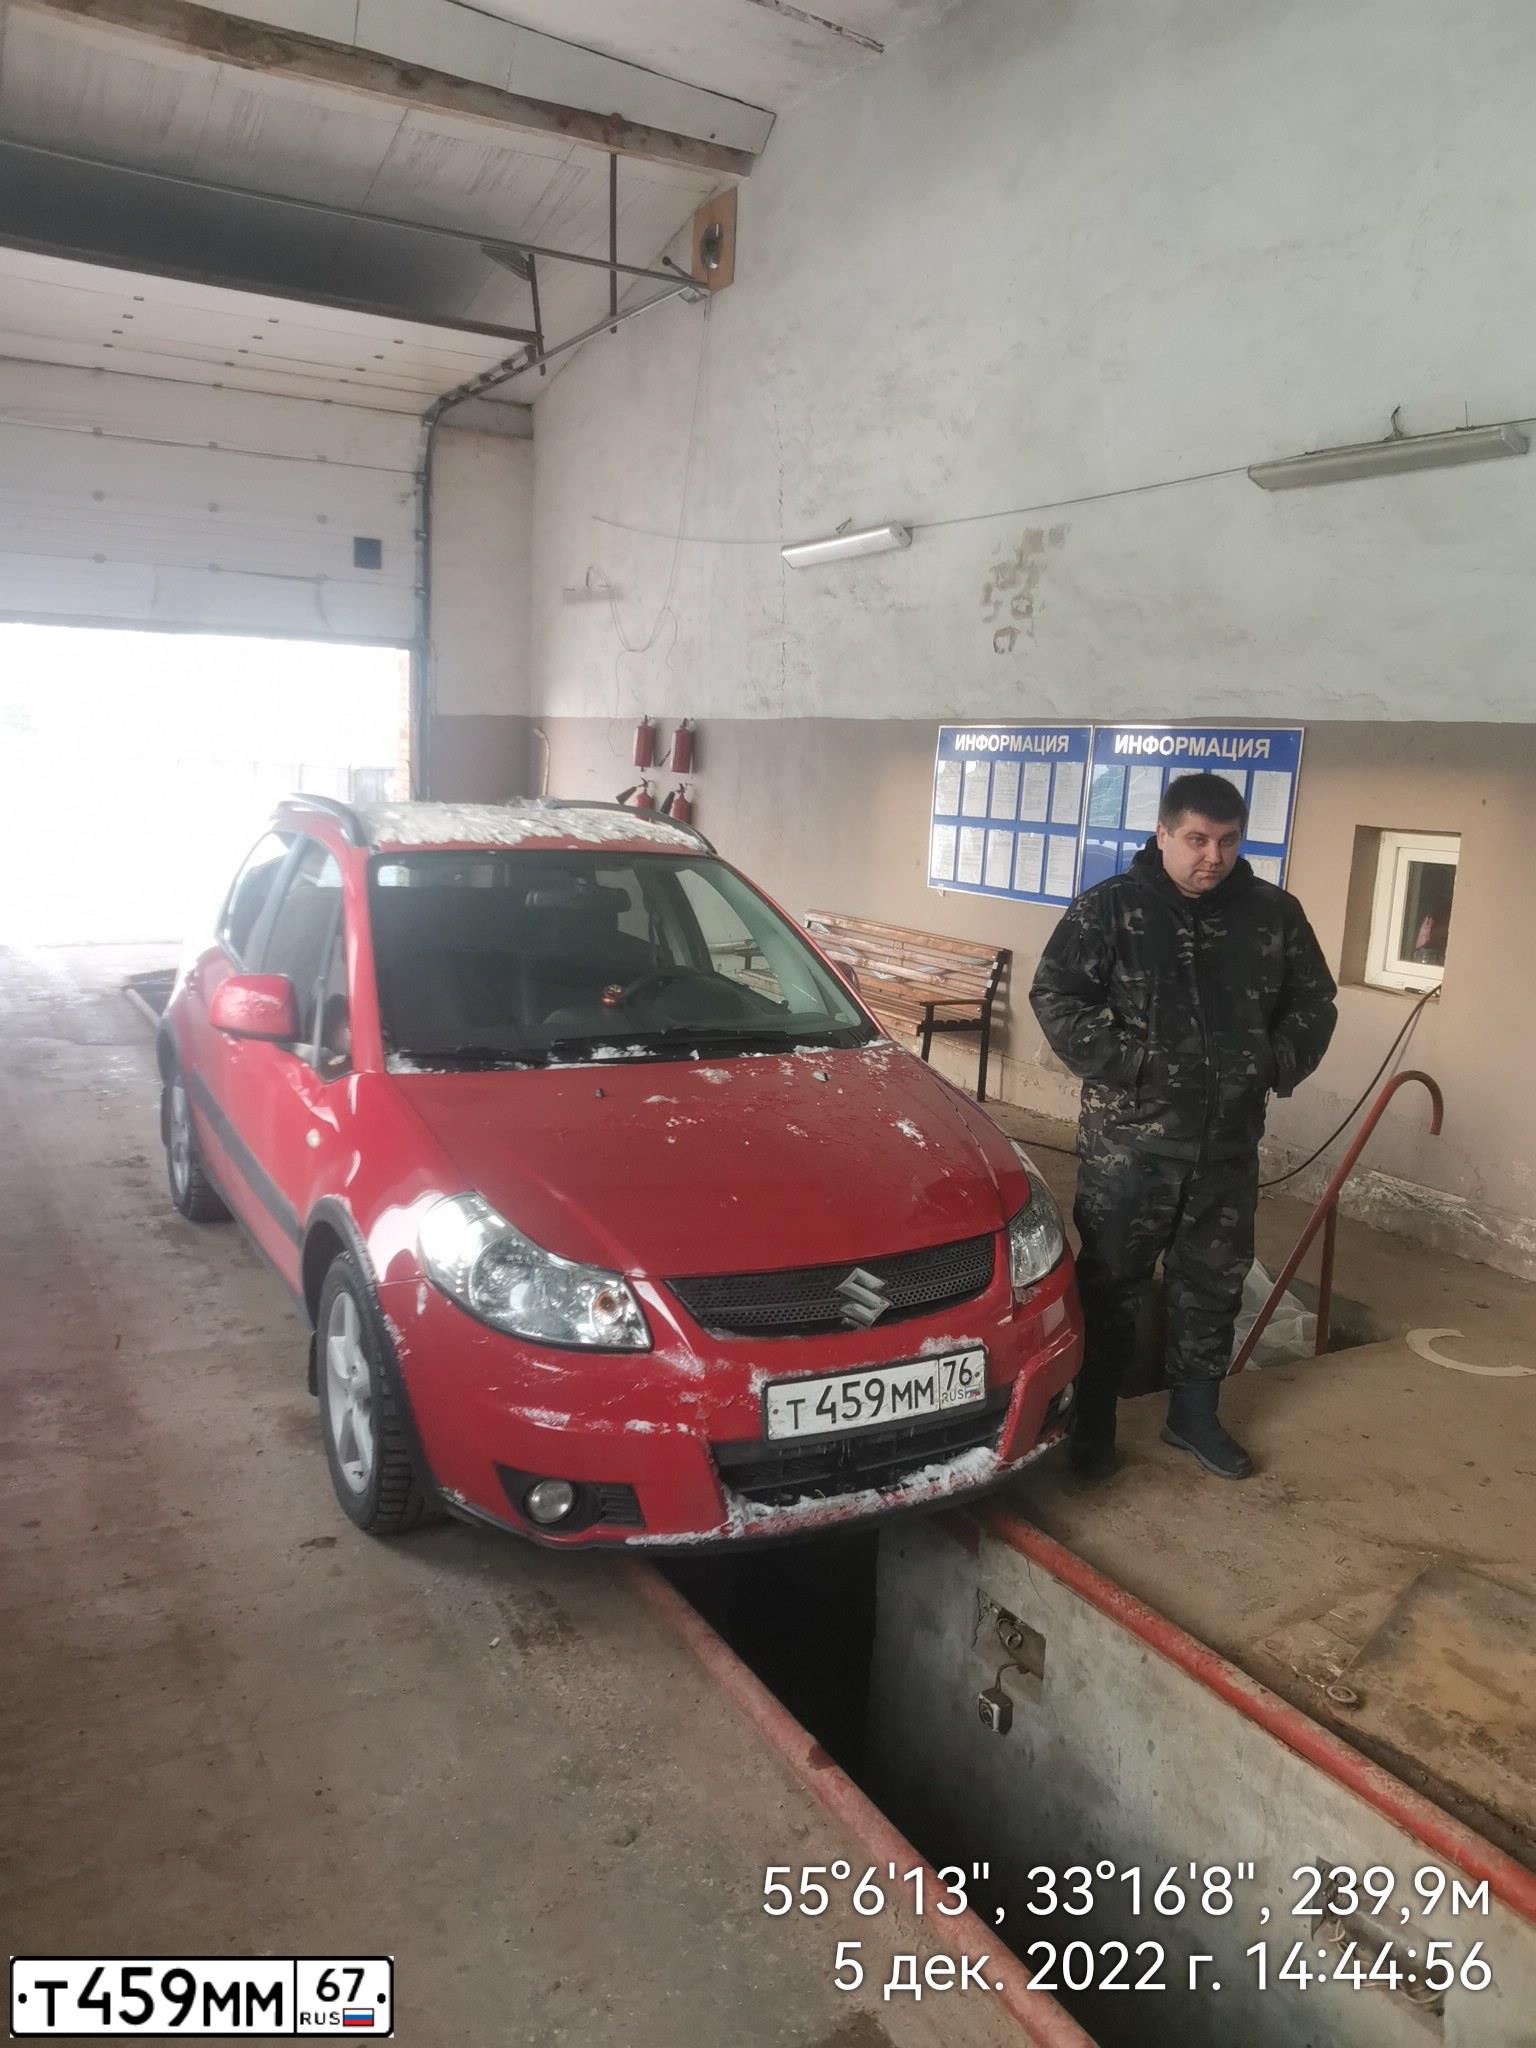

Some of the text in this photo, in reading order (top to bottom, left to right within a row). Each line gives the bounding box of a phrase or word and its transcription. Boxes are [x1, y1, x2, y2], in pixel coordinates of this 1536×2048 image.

[954, 733, 1069, 754] ИНФОРМАЦИЯ
[1114, 734, 1271, 762] ИНФОРМАЦИЯ
[943, 1357, 973, 1391] 76
